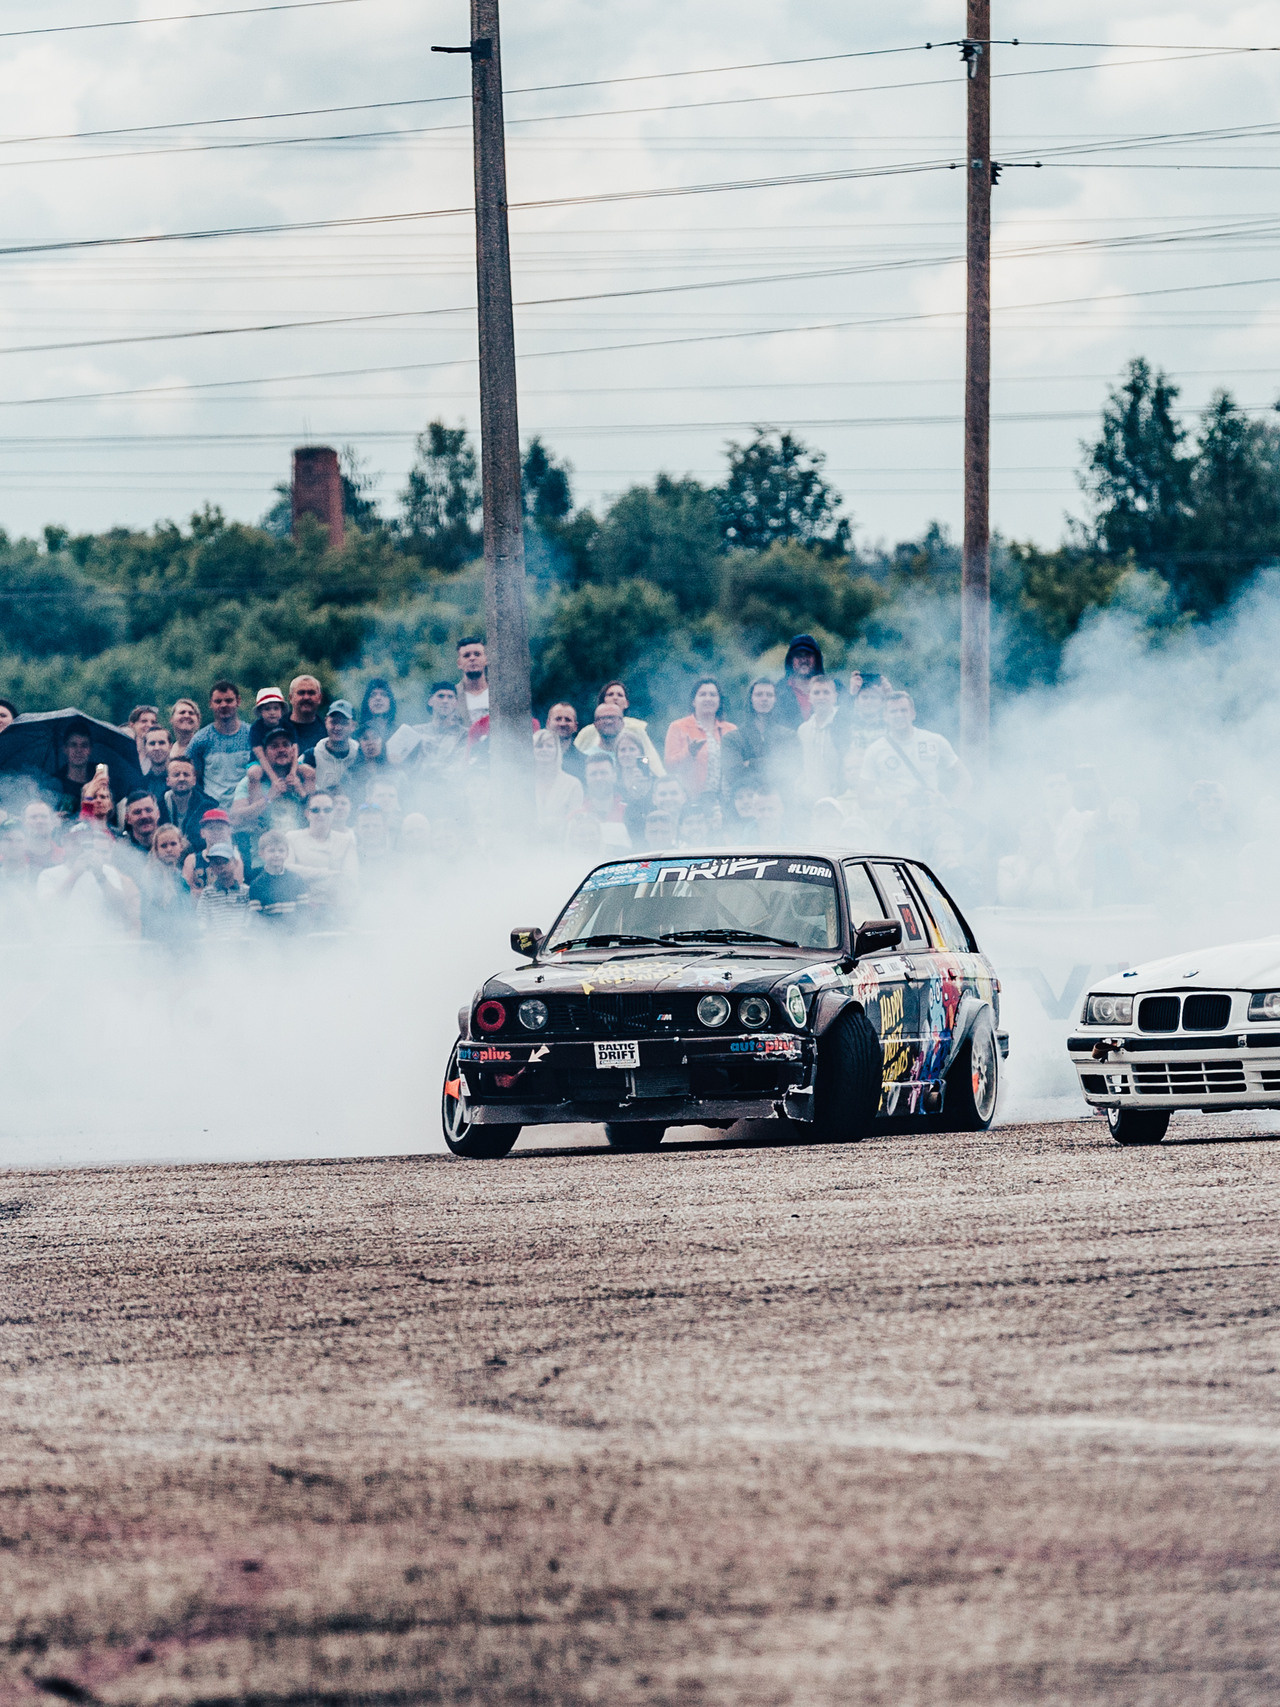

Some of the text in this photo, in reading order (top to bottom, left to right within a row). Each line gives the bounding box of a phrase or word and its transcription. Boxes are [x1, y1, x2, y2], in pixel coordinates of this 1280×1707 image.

[657, 859, 779, 883] DRIFT
[788, 863, 832, 879] #LVDRI
[598, 1043, 635, 1051] BALTIC
[598, 1050, 636, 1060] DRIFT
